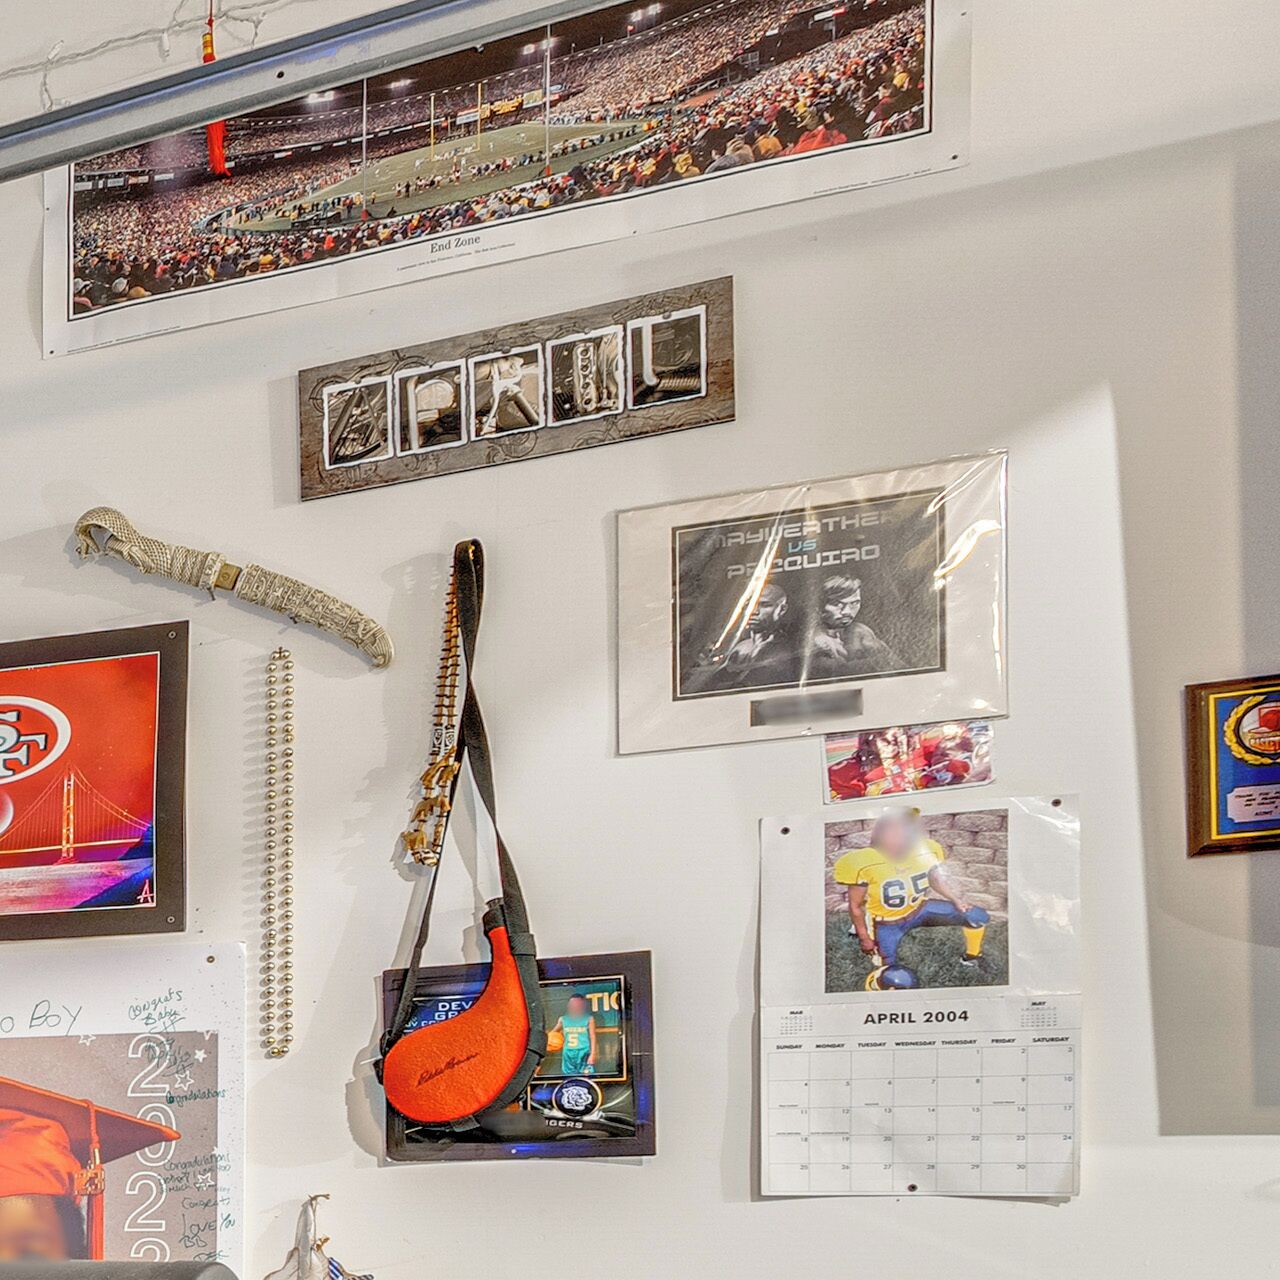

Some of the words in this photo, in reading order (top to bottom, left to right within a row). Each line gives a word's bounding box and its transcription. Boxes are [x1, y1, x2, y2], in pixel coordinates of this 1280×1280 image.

[430, 240, 451, 253] End
[454, 235, 481, 247] Zone
[788, 539, 817, 553] VS
[435, 1011, 458, 1020] GR
[863, 1013, 916, 1024] APRIL
[923, 1011, 969, 1023] 2004
[568, 1034, 579, 1047] 5
[546, 1119, 583, 1128] IGERS
